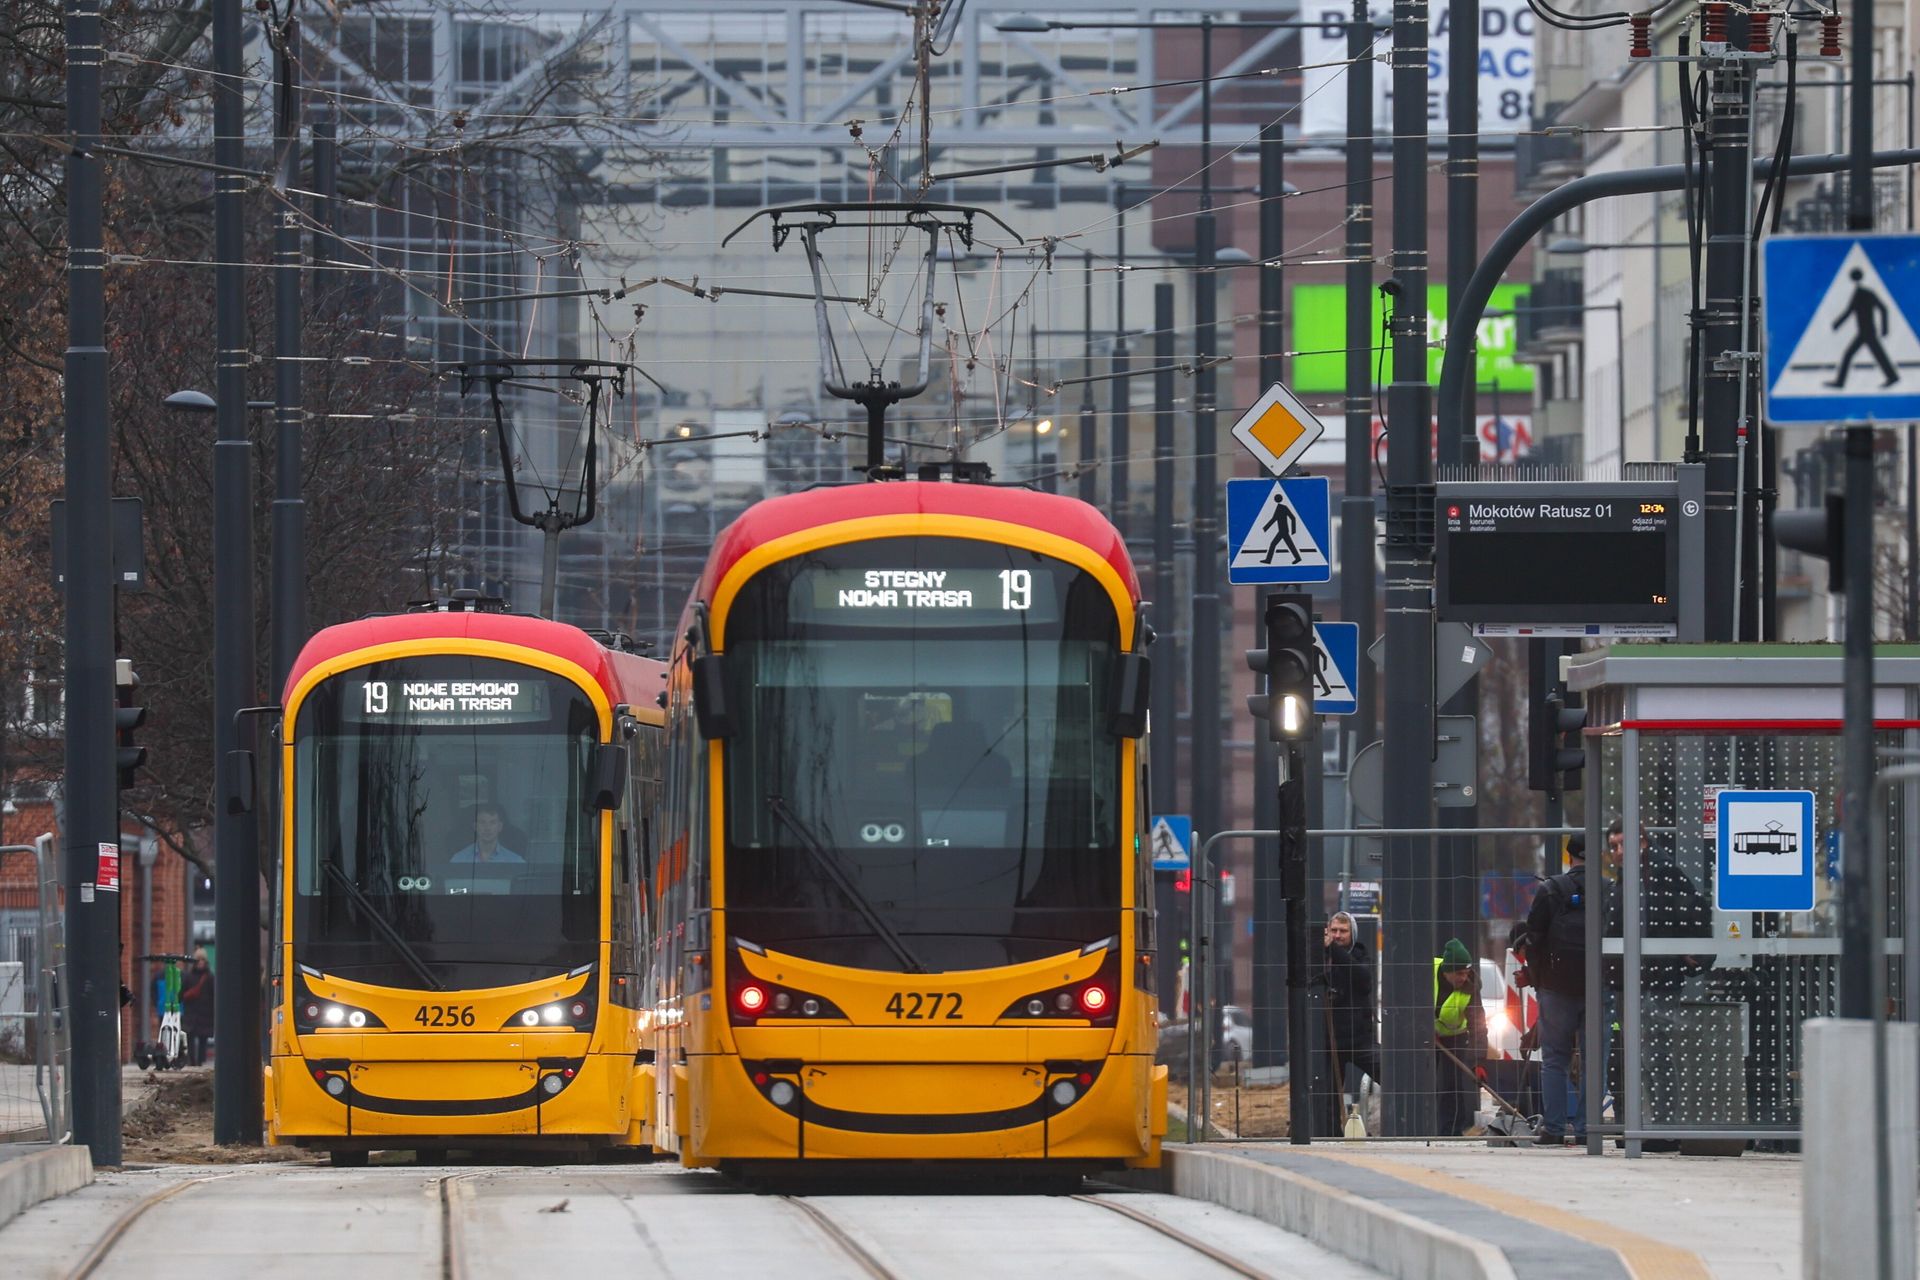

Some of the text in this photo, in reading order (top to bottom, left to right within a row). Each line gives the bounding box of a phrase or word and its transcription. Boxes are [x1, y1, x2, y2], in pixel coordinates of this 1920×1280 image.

[1469, 503, 1613, 518] Mokotów Ratusz 01
[1640, 504, 1665, 513] 12:34
[865, 570, 946, 588] STEGNY
[998, 569, 1032, 610] 19
[839, 590, 973, 607] NOWA TRASA
[362, 681, 388, 713] 19
[403, 683, 519, 696] NOWE BEMOWO
[409, 698, 512, 711] NOWA TRASA
[885, 992, 963, 1019] 4272
[414, 1005, 475, 1027] 4256
